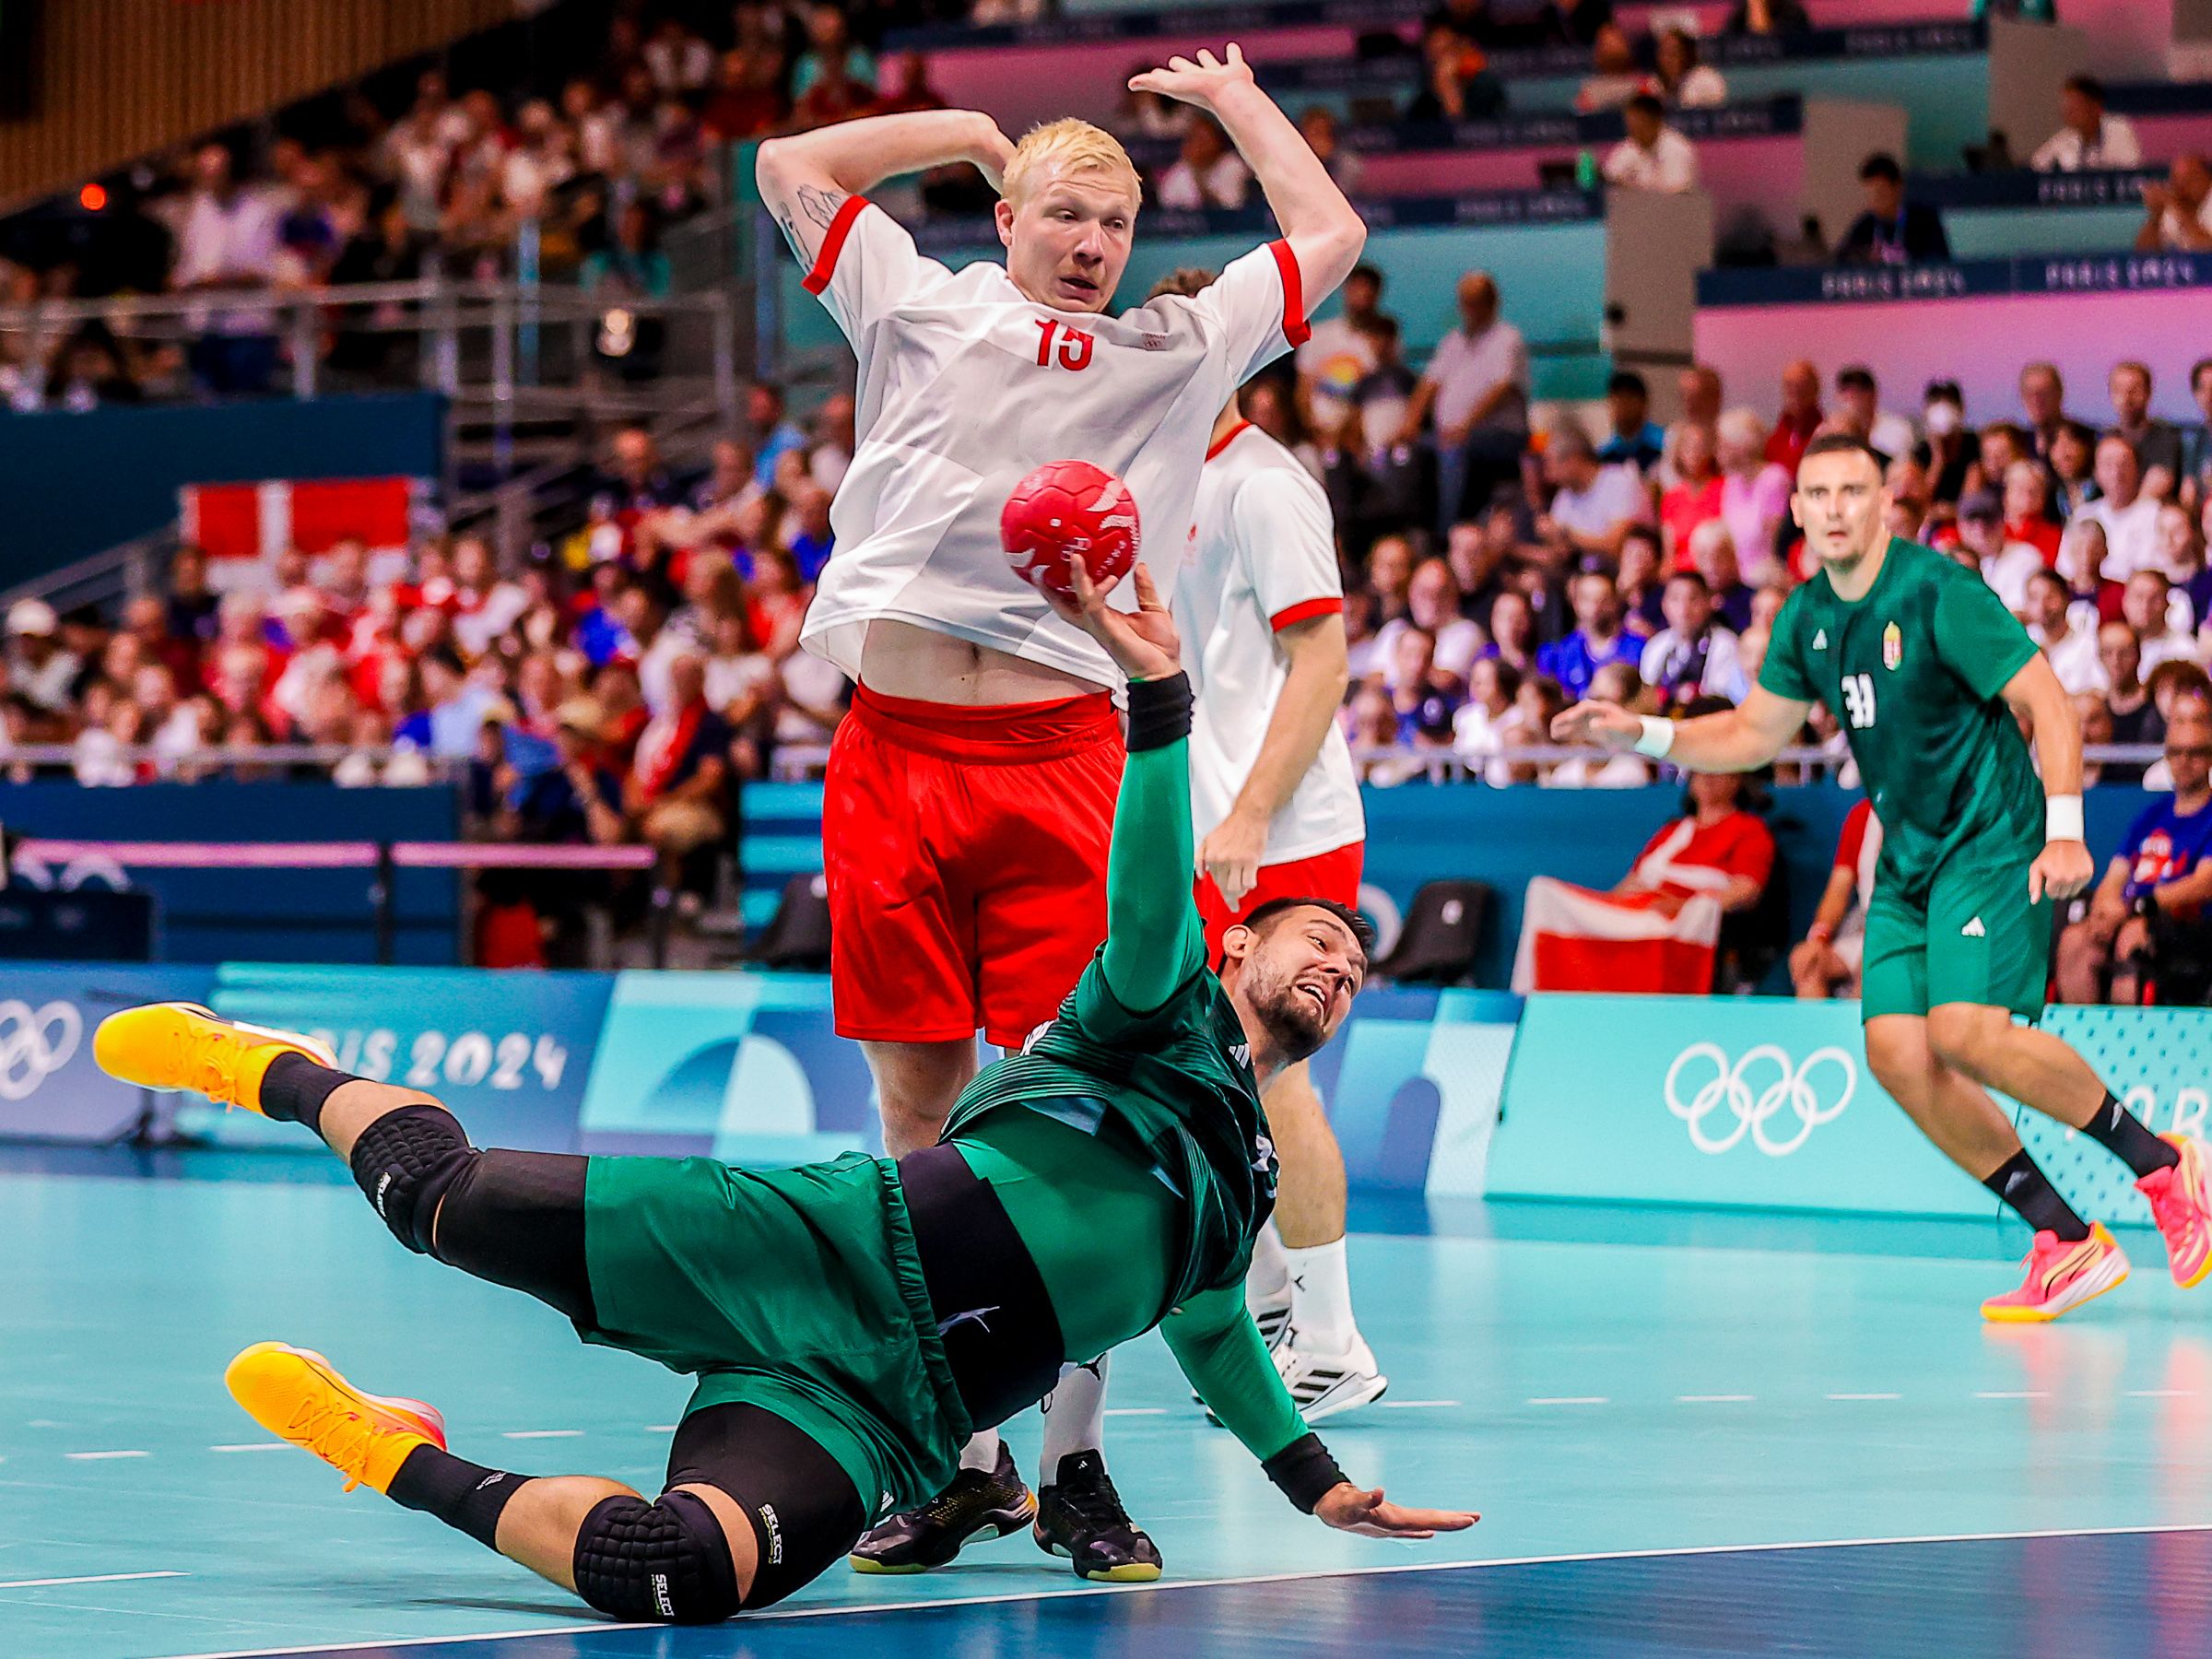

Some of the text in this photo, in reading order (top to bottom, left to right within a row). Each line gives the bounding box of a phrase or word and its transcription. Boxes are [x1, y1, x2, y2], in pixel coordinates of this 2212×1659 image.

[1034, 318, 1095, 371] 15
[403, 1029, 568, 1091] 2024
[761, 1503, 782, 1565] SELECT
[654, 1573, 675, 1621] SELECT
